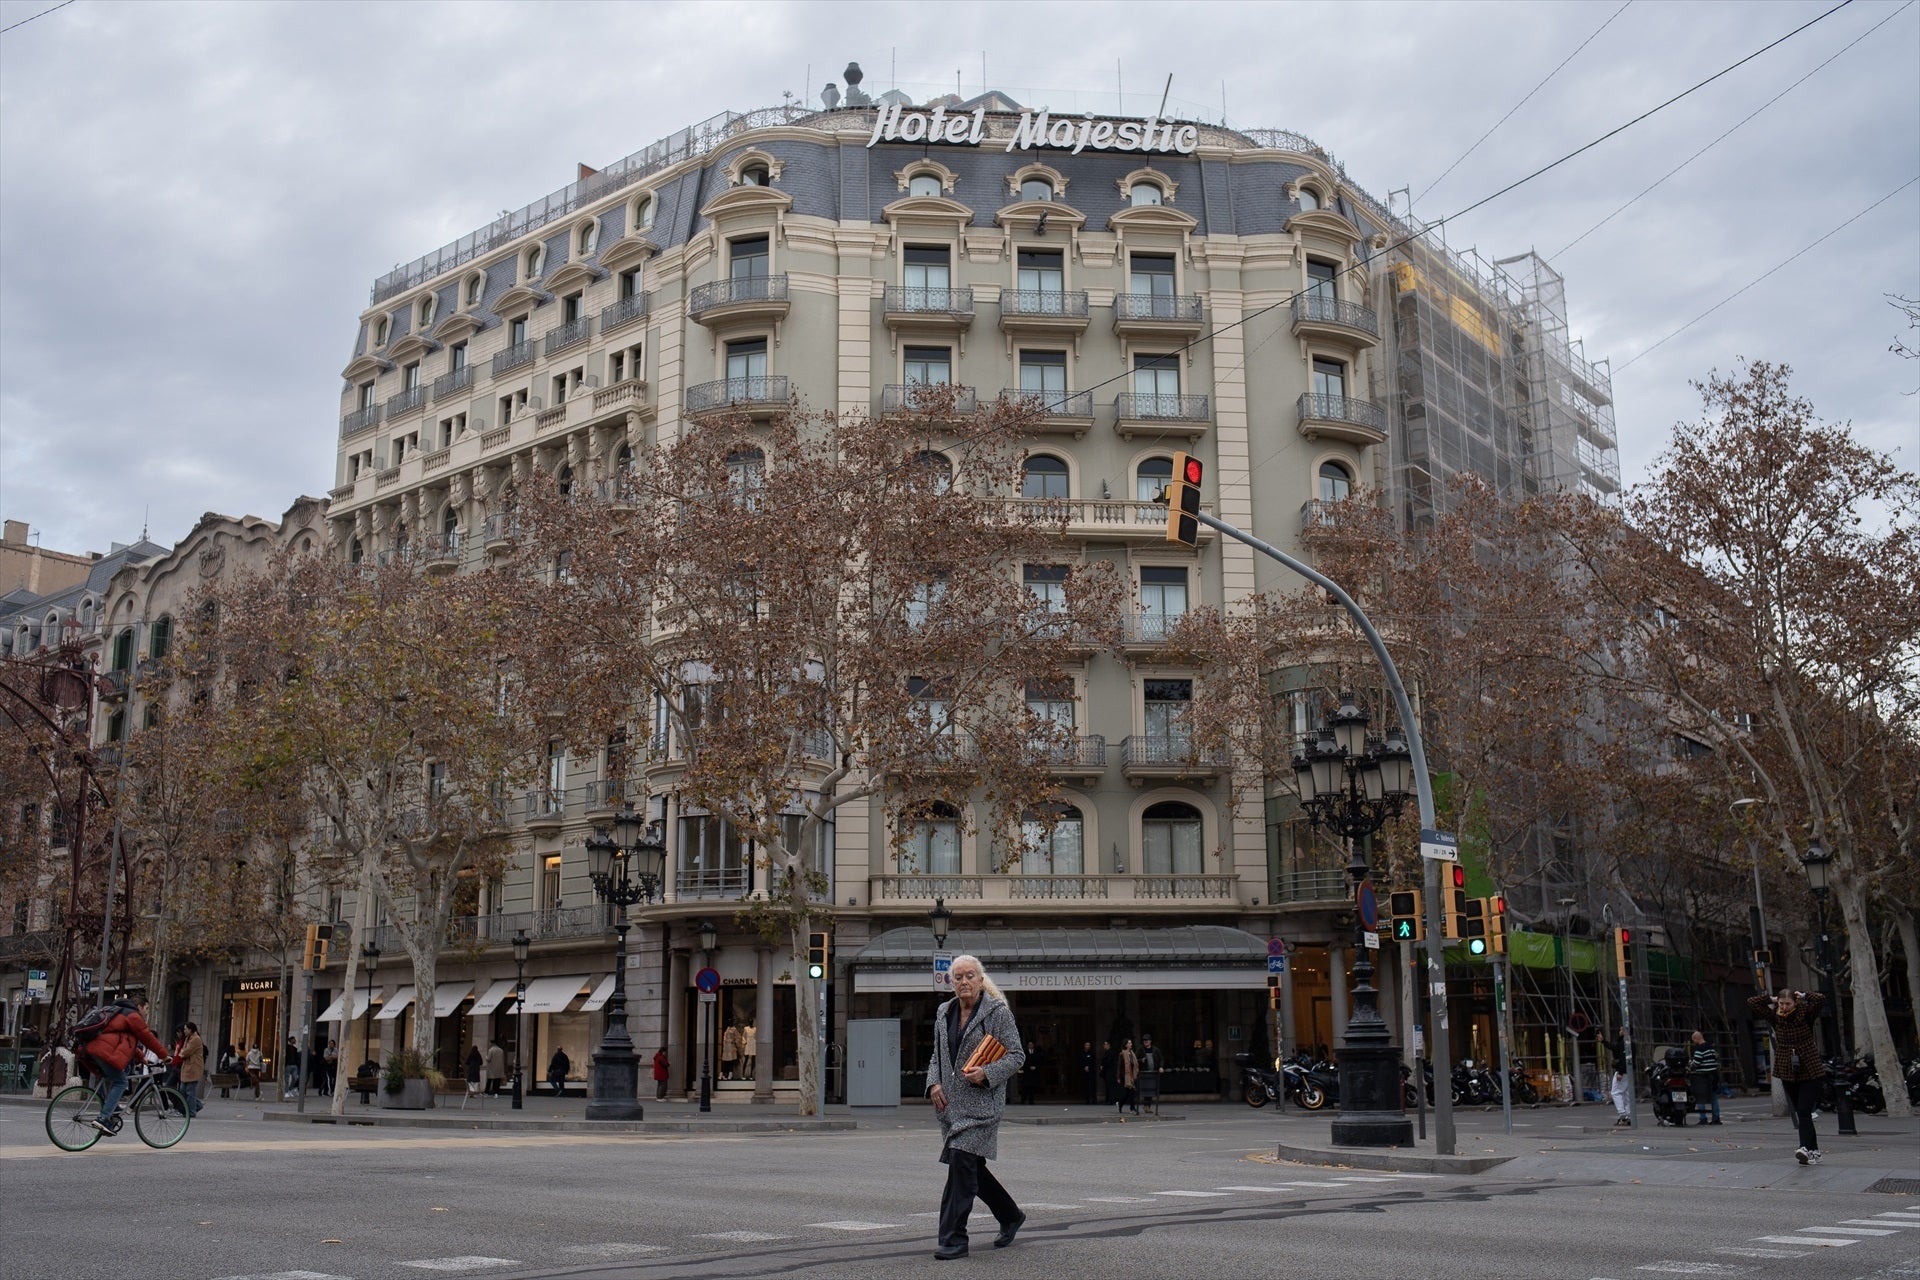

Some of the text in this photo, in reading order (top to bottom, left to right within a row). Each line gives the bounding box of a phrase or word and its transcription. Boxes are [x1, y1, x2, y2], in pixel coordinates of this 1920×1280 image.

[866, 103, 1198, 155] Hotel Majestic
[240, 981, 273, 990] BVLGARI
[1019, 975, 1122, 987] HOTEL MAJESTIC
